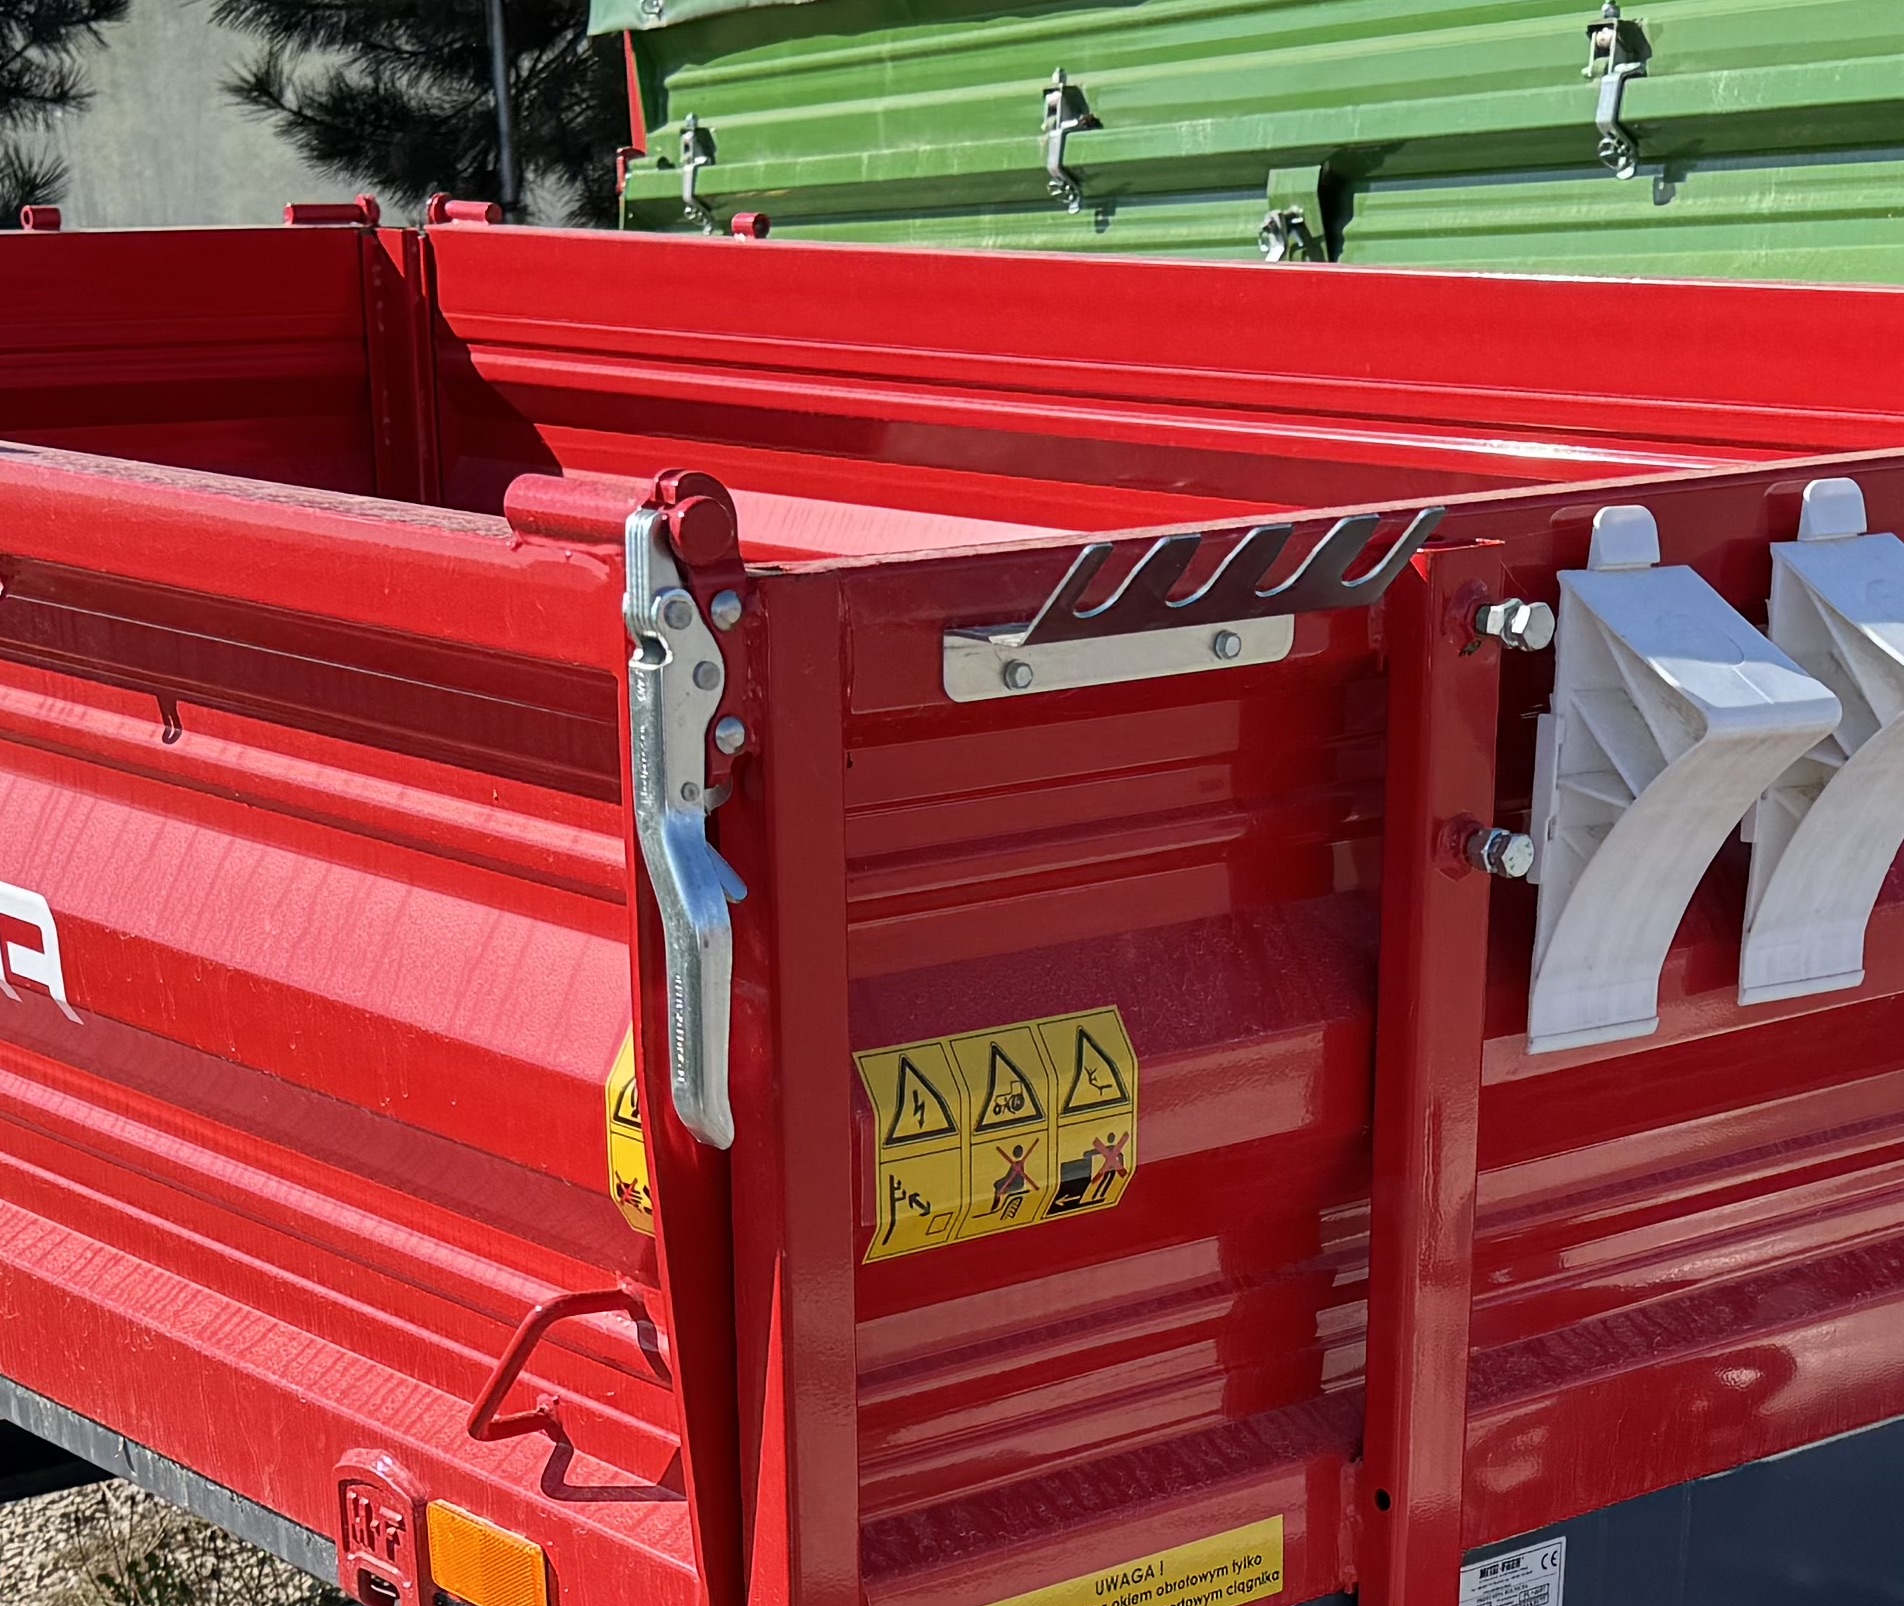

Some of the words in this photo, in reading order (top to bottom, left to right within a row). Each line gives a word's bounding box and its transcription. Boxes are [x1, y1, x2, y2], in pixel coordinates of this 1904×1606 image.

[1095, 1563, 1156, 1596] UWAGA
[1156, 1564, 1229, 1599] obrotowym
[1232, 1553, 1263, 1576] tylko
[1226, 1568, 1281, 1597] ciągnika
